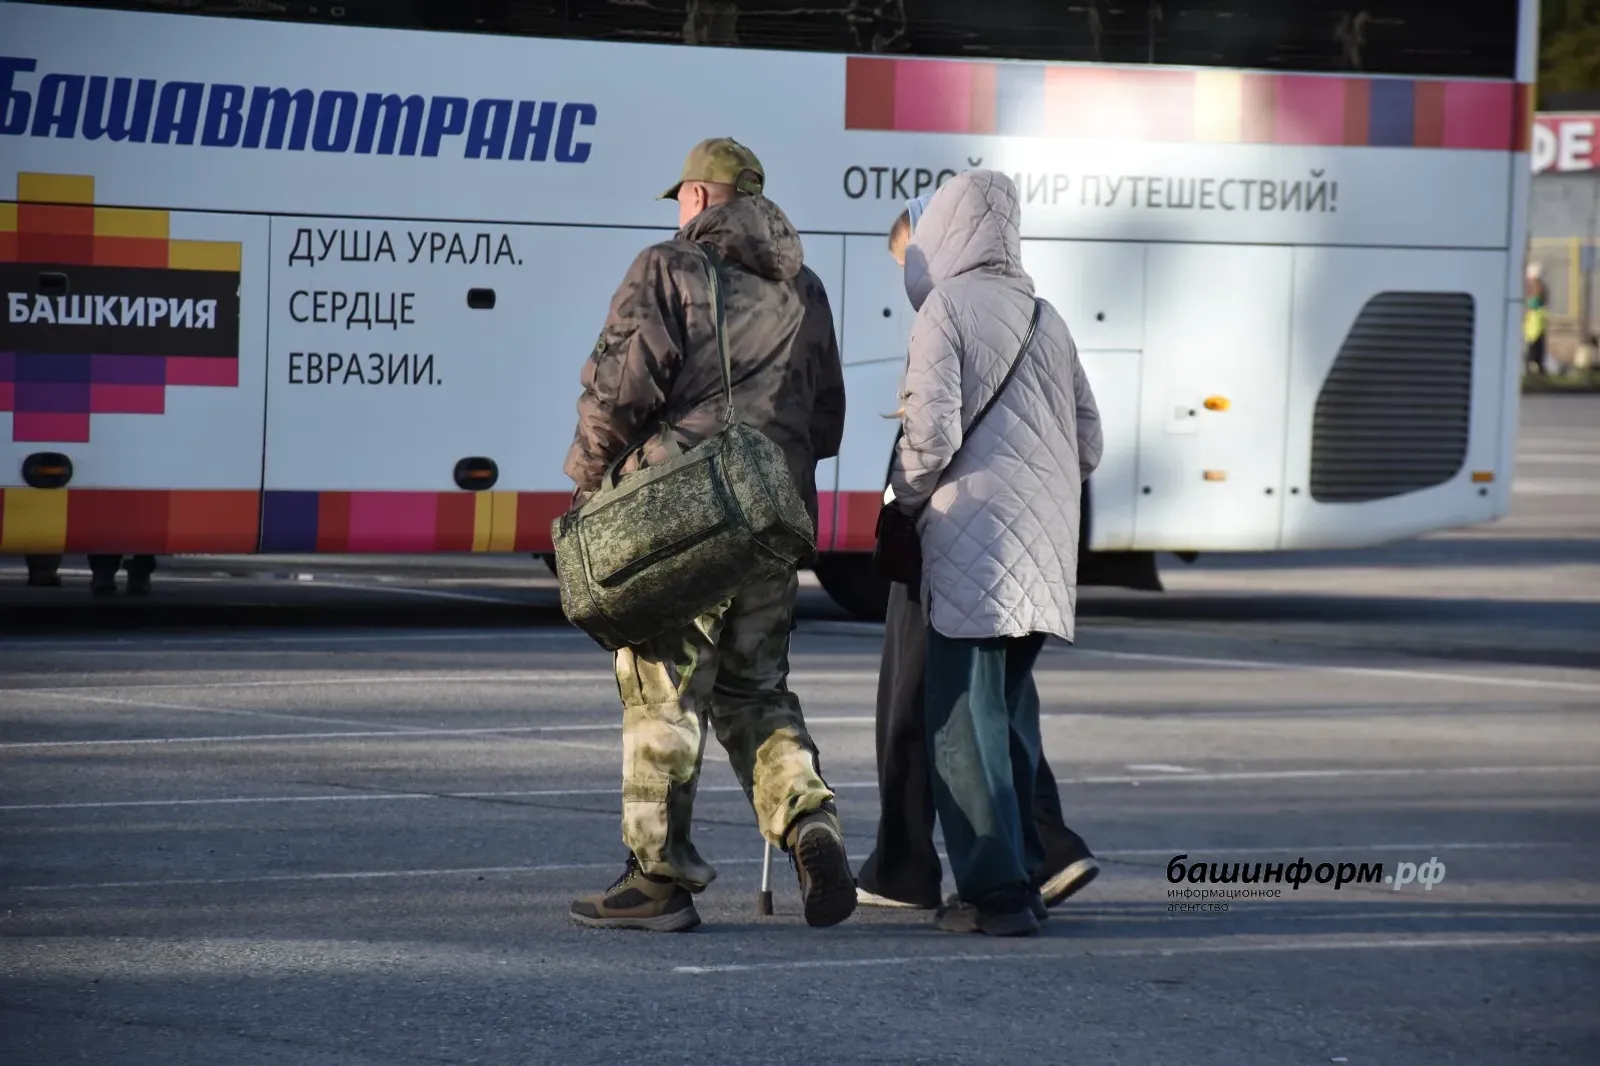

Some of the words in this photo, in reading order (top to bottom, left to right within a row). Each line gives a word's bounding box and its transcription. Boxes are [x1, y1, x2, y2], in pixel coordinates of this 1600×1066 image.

[1080, 168, 1339, 213] ПУТЕШЕСТВИЙ!
[288, 228, 397, 267] ДУША
[407, 232, 524, 266] УРАЛА.
[7, 292, 218, 330] БАШКИРИЯ
[288, 290, 416, 331] СЕРДЦЕ
[288, 352, 443, 386] ЕВРАЗИИ.
